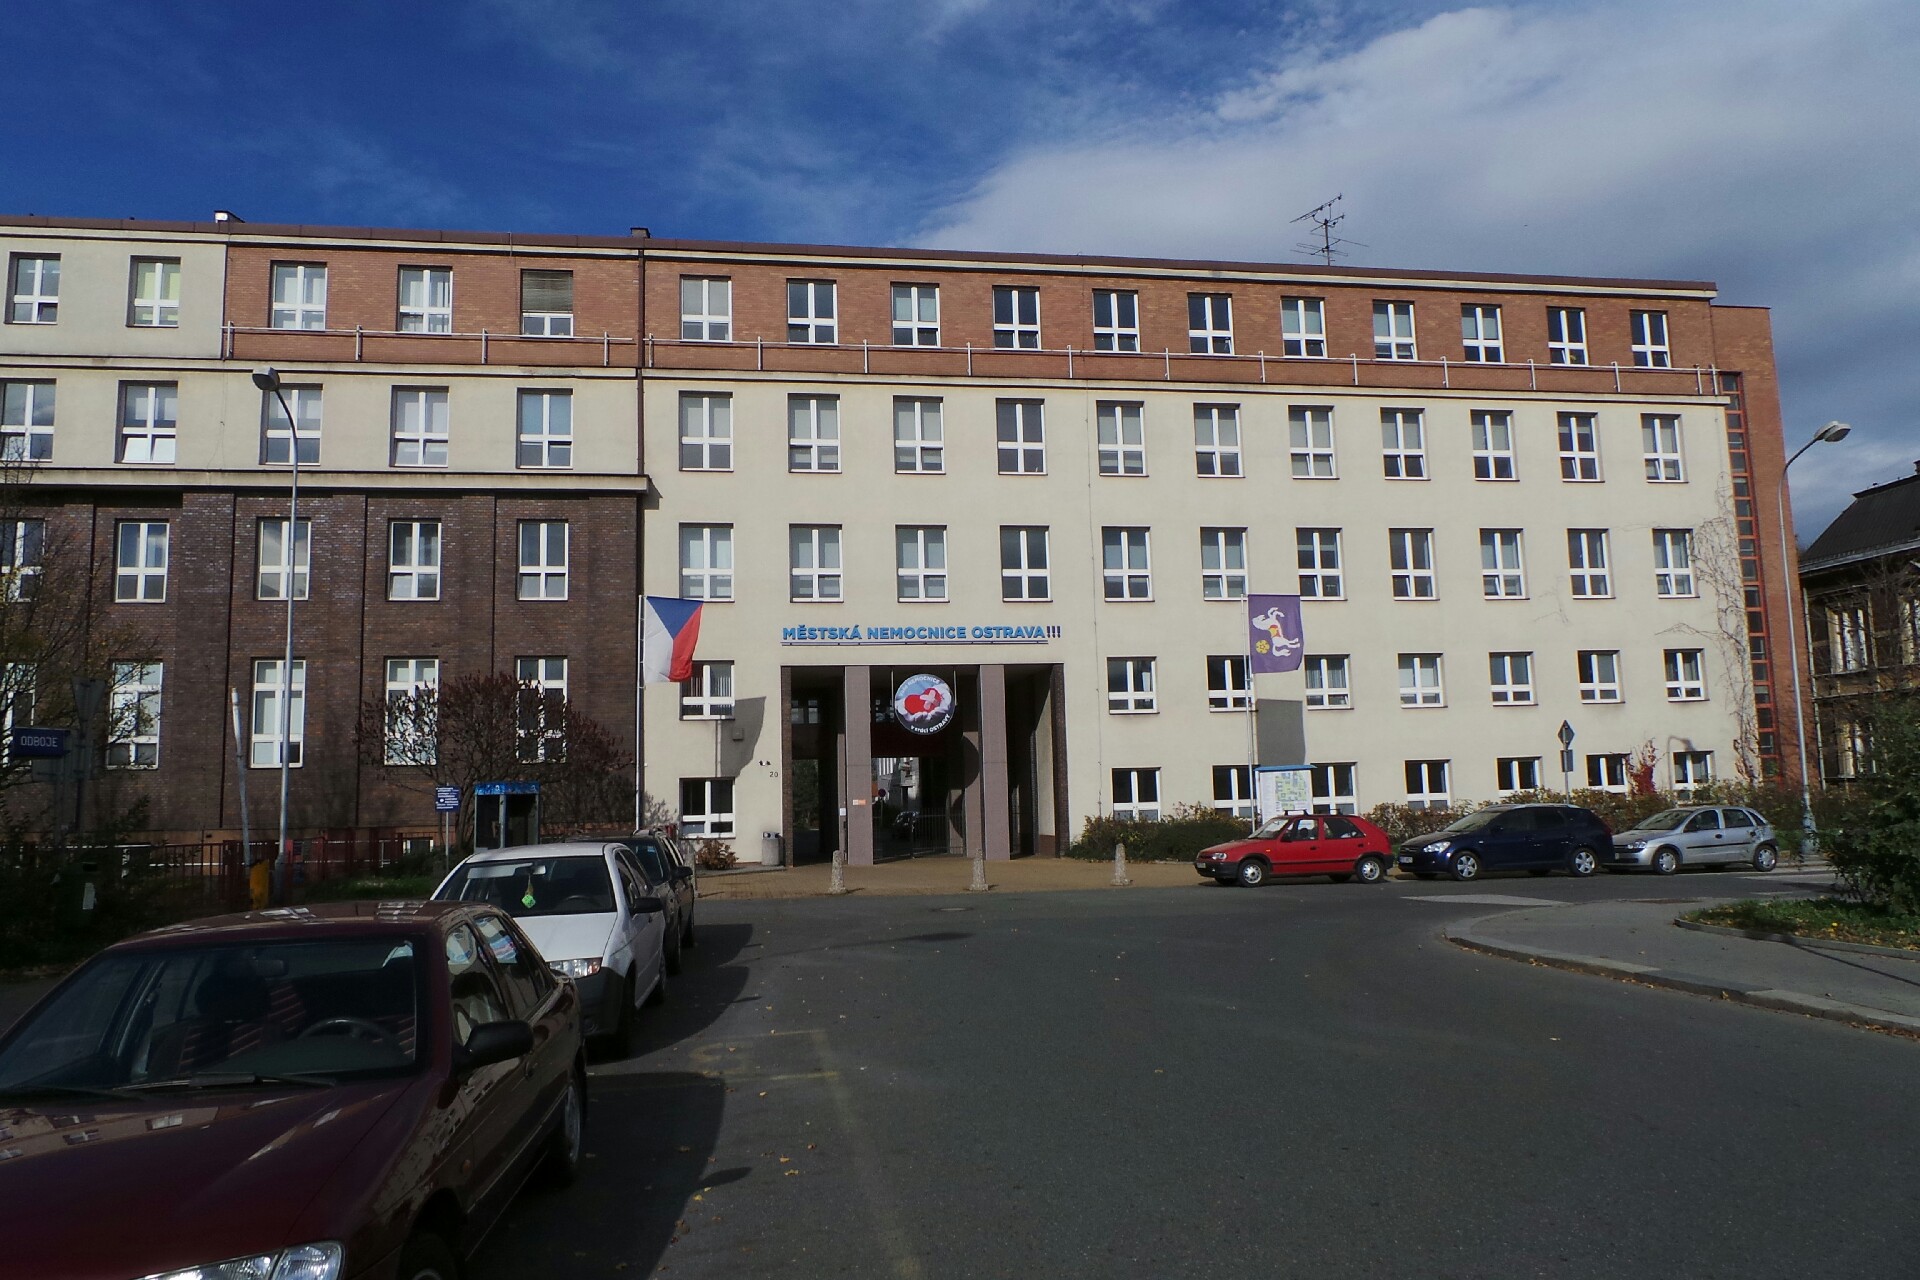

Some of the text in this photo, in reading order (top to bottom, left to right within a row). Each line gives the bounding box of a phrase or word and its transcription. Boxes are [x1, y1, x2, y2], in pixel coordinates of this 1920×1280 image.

[782, 624, 862, 640] MĚSTSKÁ
[867, 626, 967, 640] NEMOCNICE
[929, 713, 950, 732] OSTRAVY
